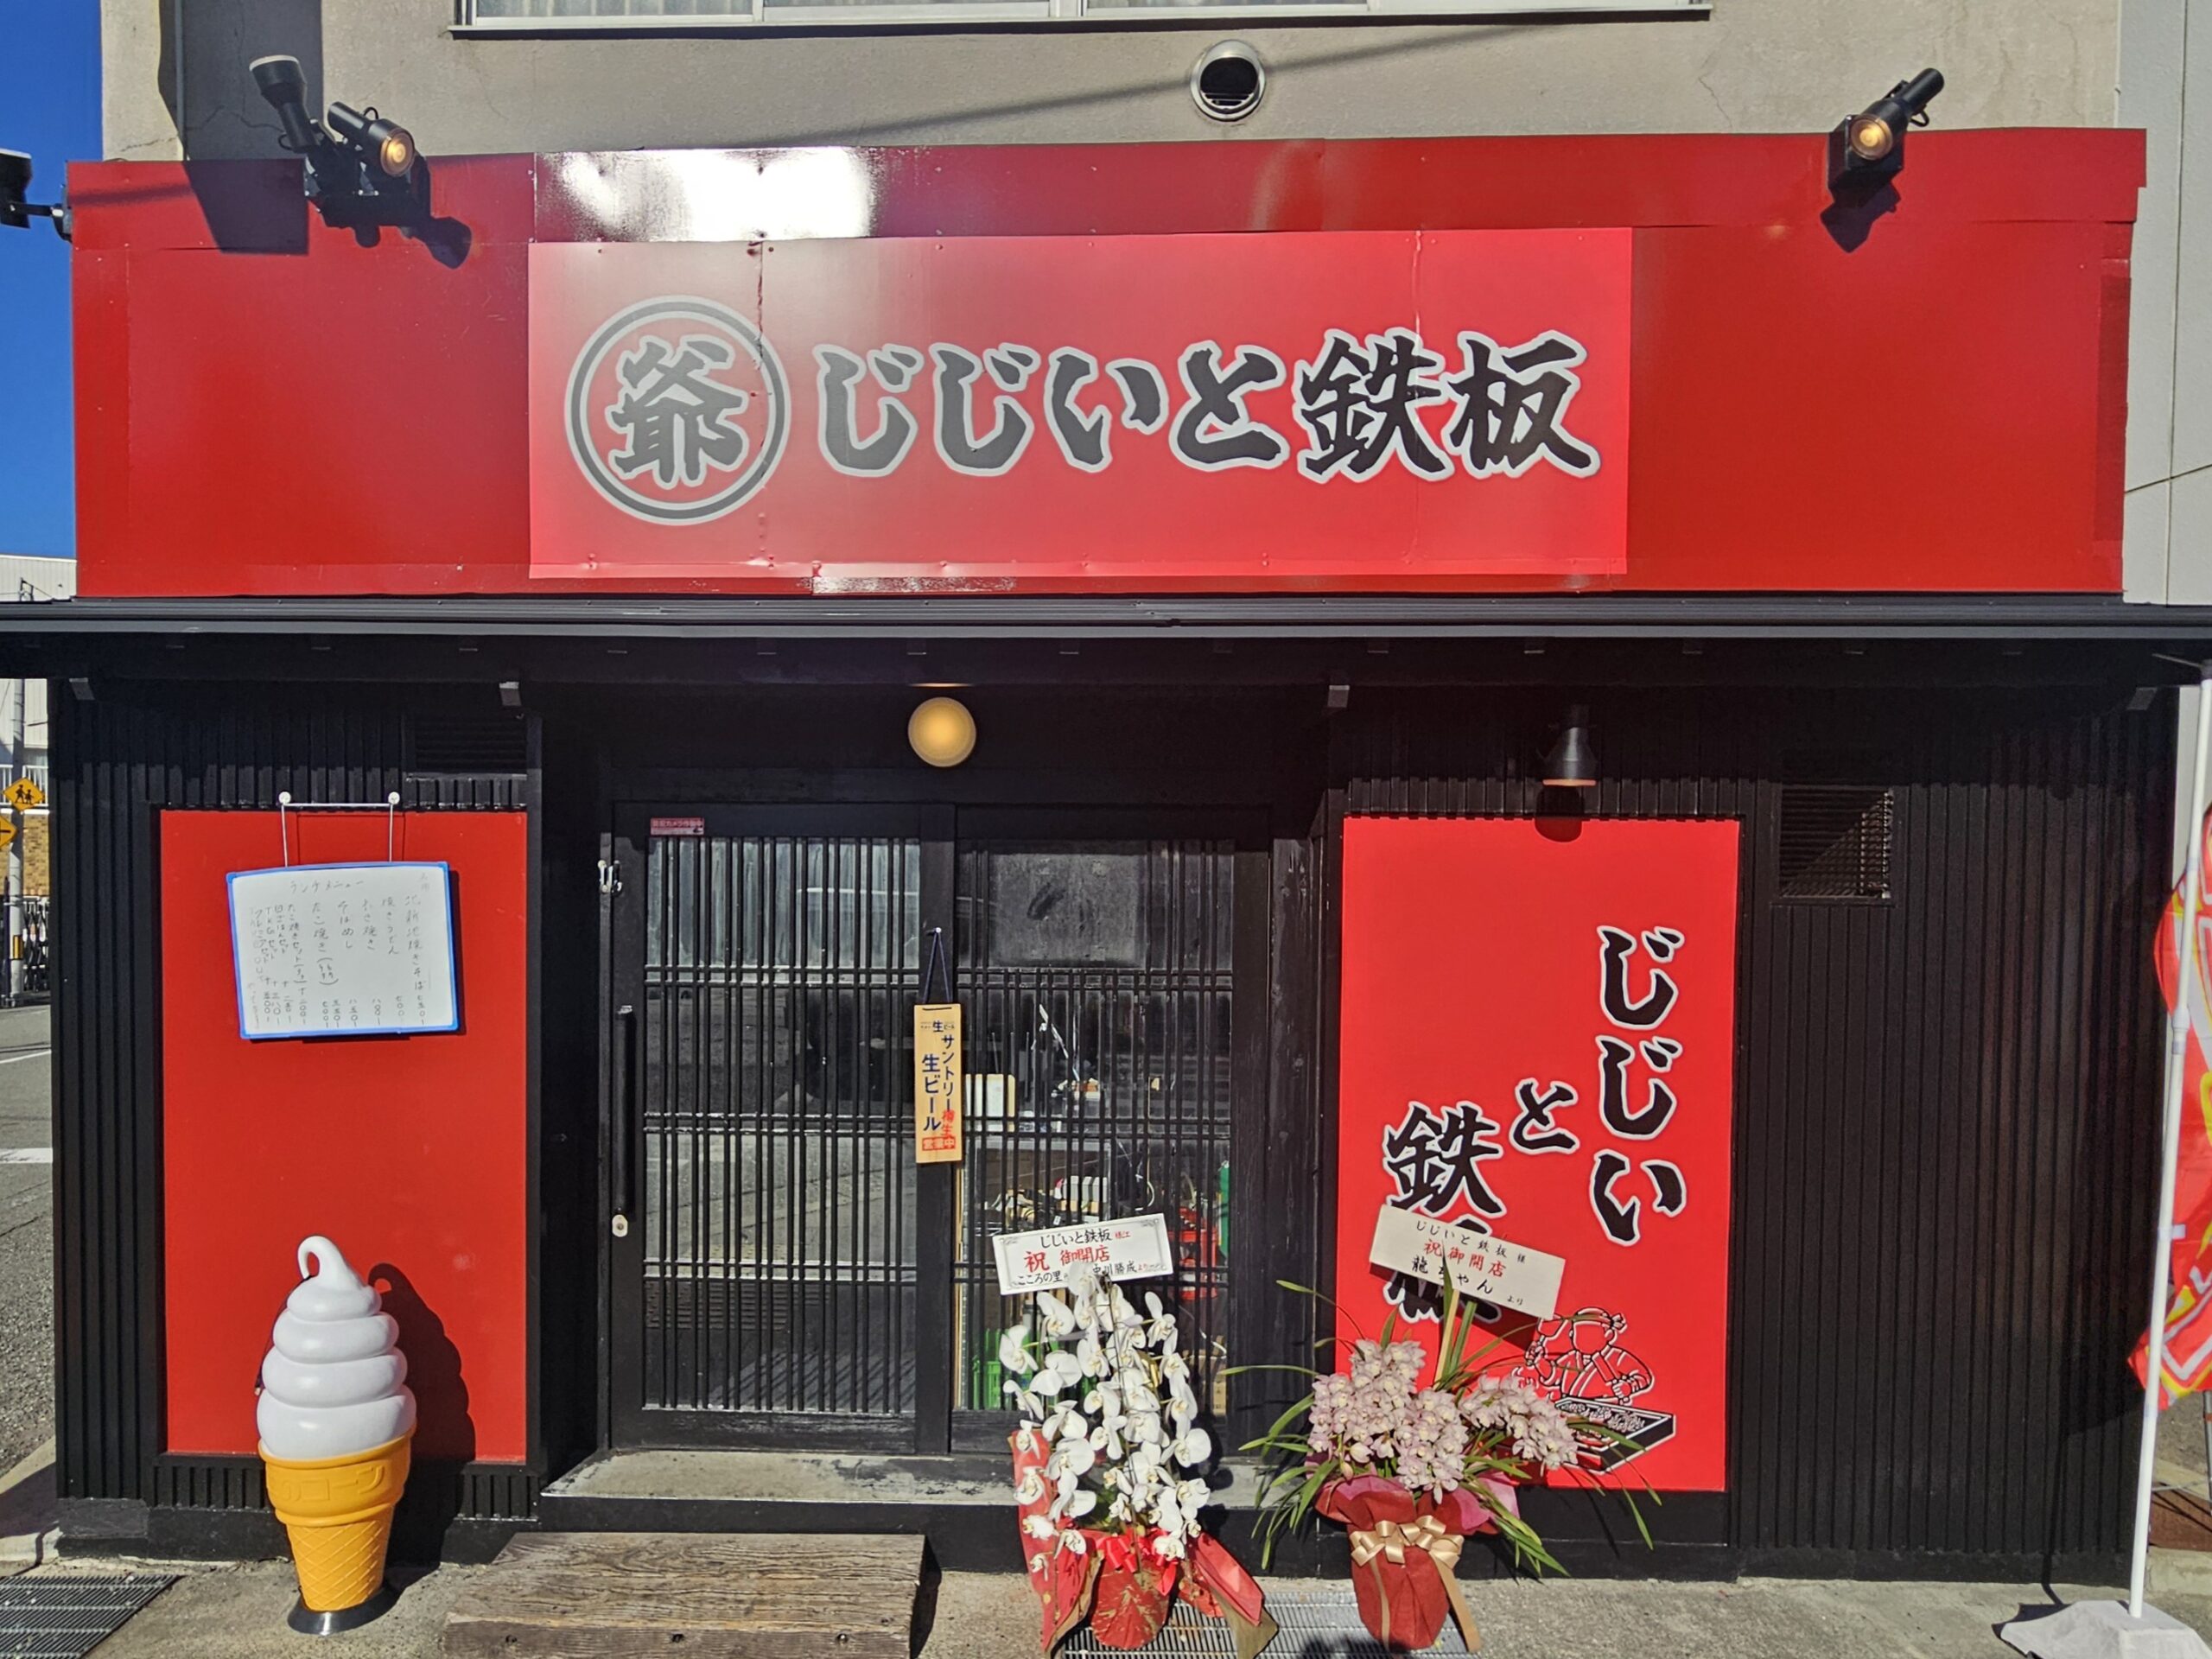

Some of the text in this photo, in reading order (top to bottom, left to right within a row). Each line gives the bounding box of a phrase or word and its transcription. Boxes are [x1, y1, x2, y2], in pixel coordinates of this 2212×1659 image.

[608, 334, 751, 490] 爺
[812, 327, 1601, 484] じじいと鉄板
[921, 1053, 942, 1132] 生ビール
[941, 1034, 955, 1111] サントリー
[1590, 925, 1687, 1246] じじい
[922, 1137, 957, 1152] 営業中
[1509, 1078, 1580, 1153] と
